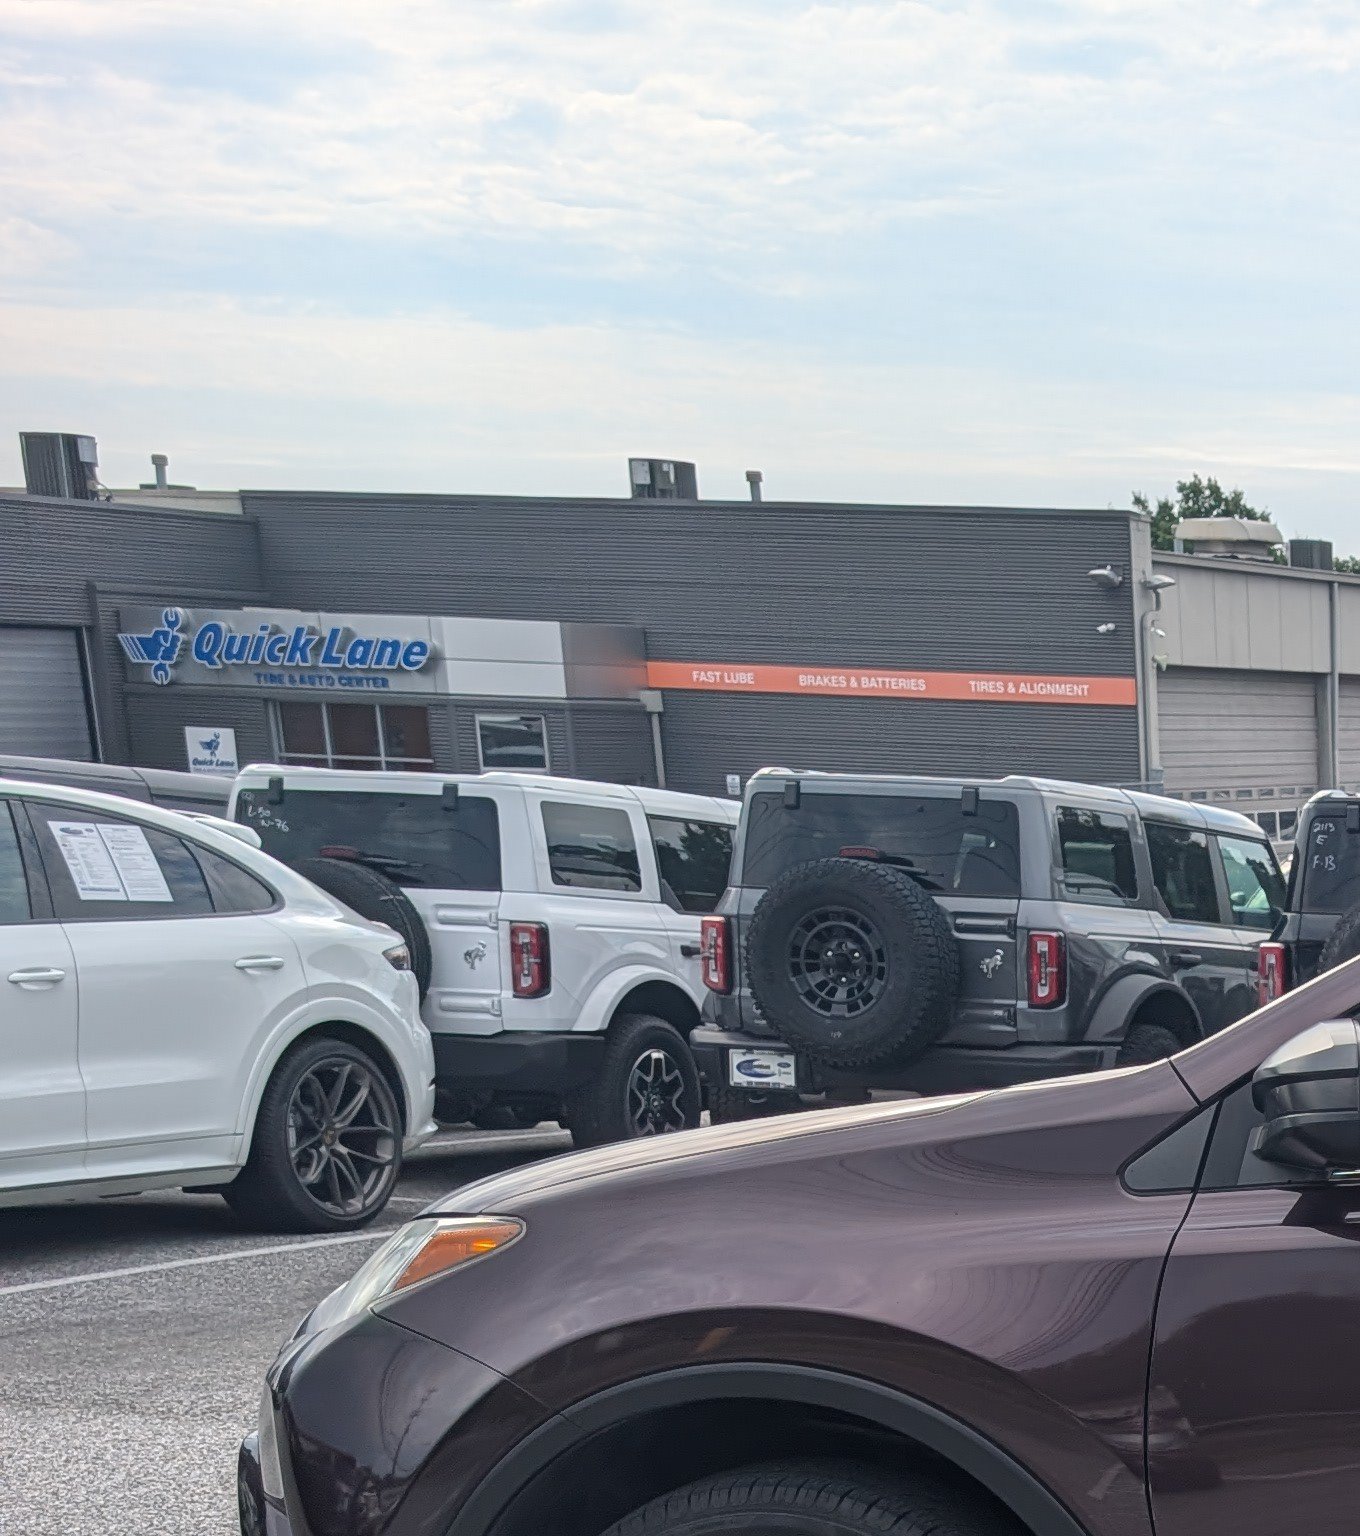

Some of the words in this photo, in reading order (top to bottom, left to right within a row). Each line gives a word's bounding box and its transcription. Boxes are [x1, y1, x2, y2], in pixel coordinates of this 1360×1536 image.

[194, 622, 319, 668] Quick
[320, 627, 431, 670] Lane
[337, 675, 390, 688] CENTER
[692, 671, 721, 683] FAST
[723, 672, 755, 685] LUBE
[799, 674, 847, 688] BRAKES
[849, 676, 858, 688] &
[861, 676, 927, 691] BATTERIES
[969, 680, 1005, 694] TIRES
[1007, 681, 1016, 694] &
[1018, 682, 1089, 696] ALIGNMENT
[192, 757, 214, 766] Quick
[215, 759, 235, 767] Lane
[1316, 834, 1328, 845] E
